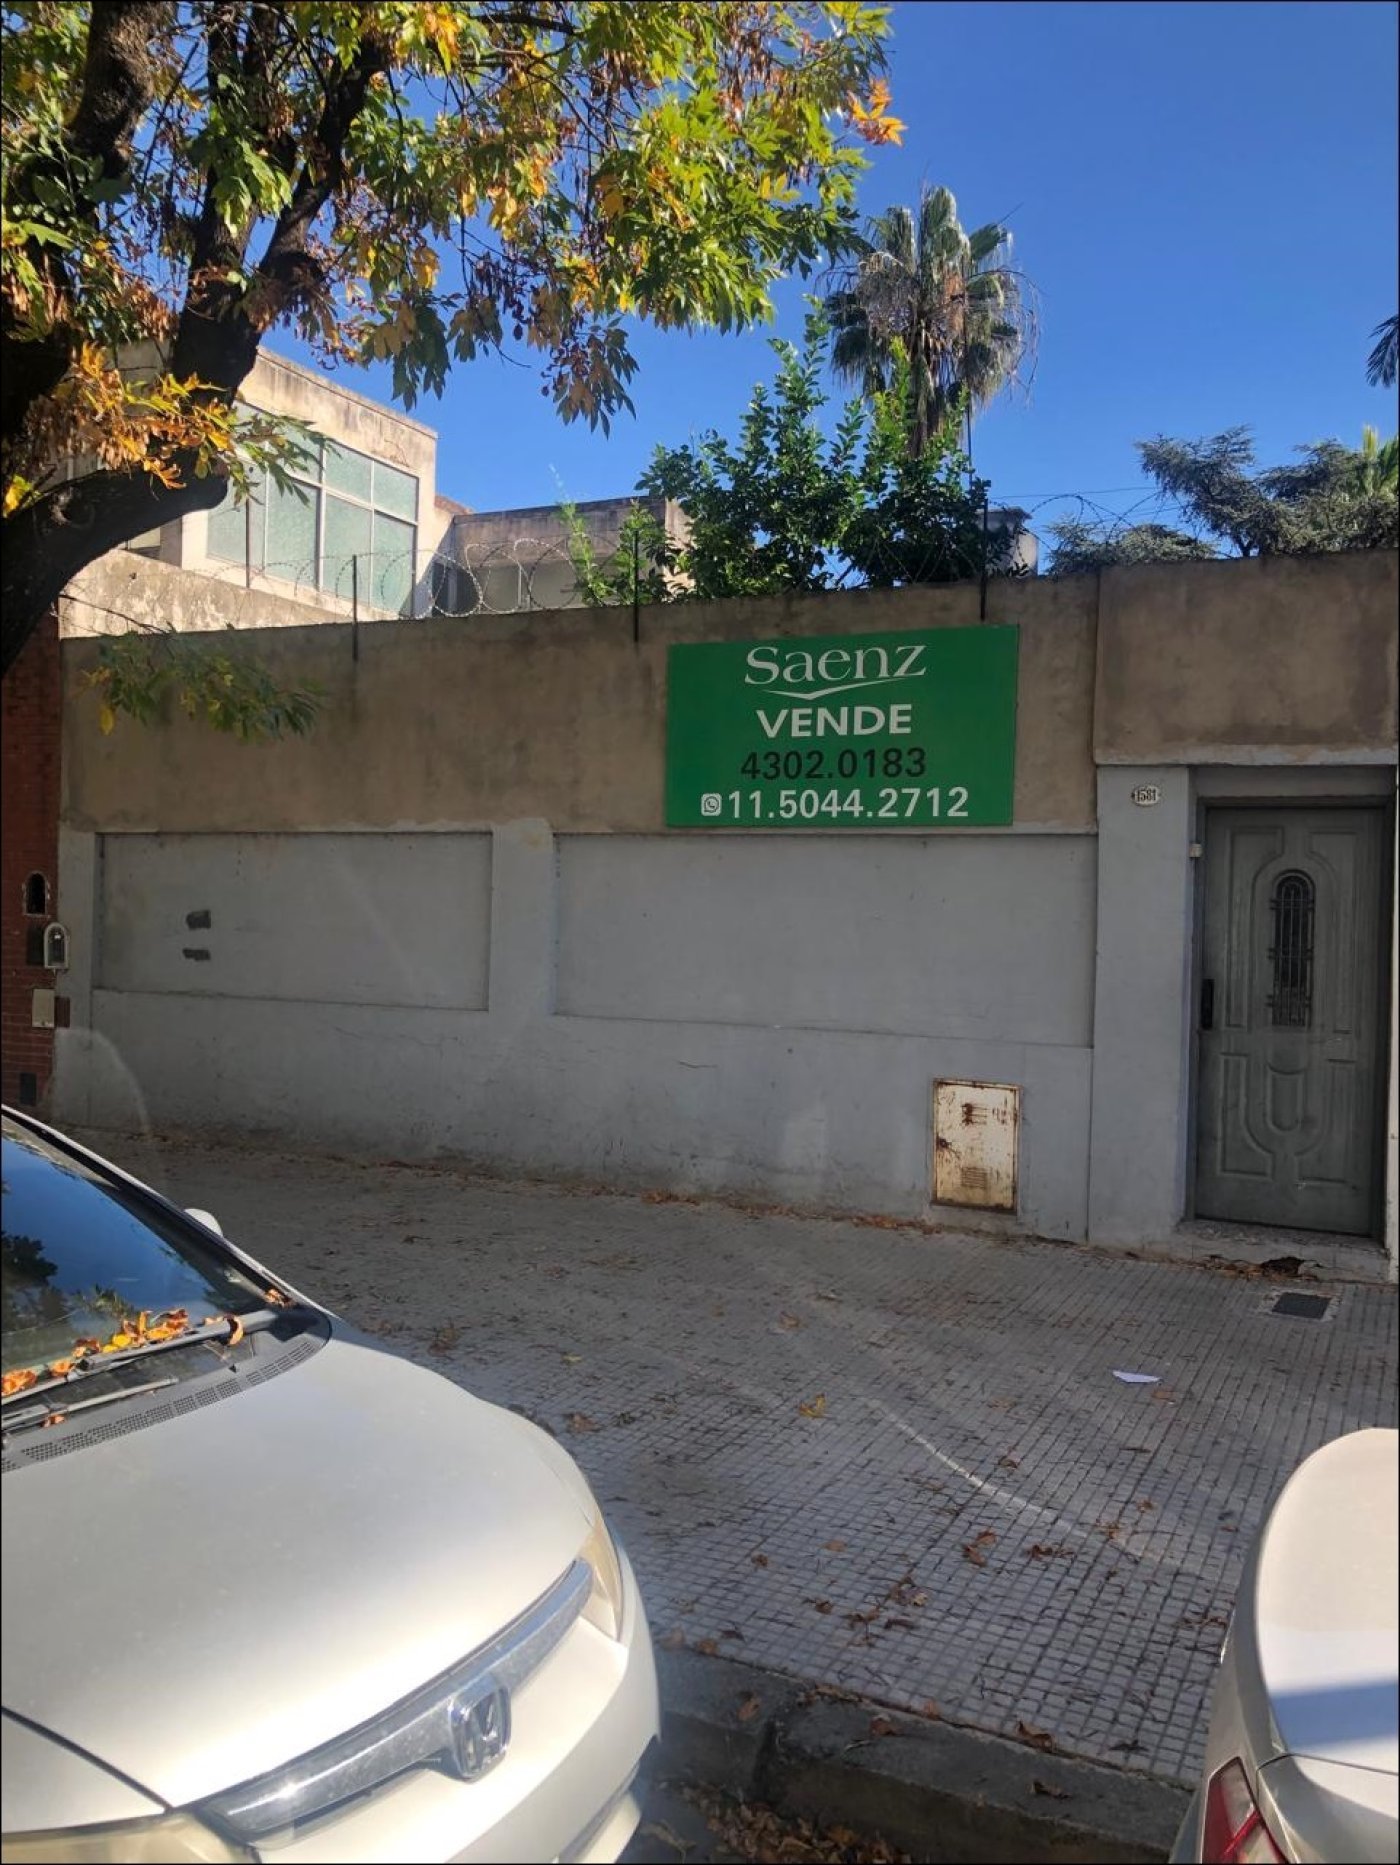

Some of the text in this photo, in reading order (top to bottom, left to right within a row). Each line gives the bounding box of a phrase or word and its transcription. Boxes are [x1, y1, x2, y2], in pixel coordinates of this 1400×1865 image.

[744, 645, 928, 684] Saenz
[756, 704, 912, 738] VENDE
[740, 747, 927, 780] 4302.0183
[728, 787, 969, 819] 11.5044.2712
